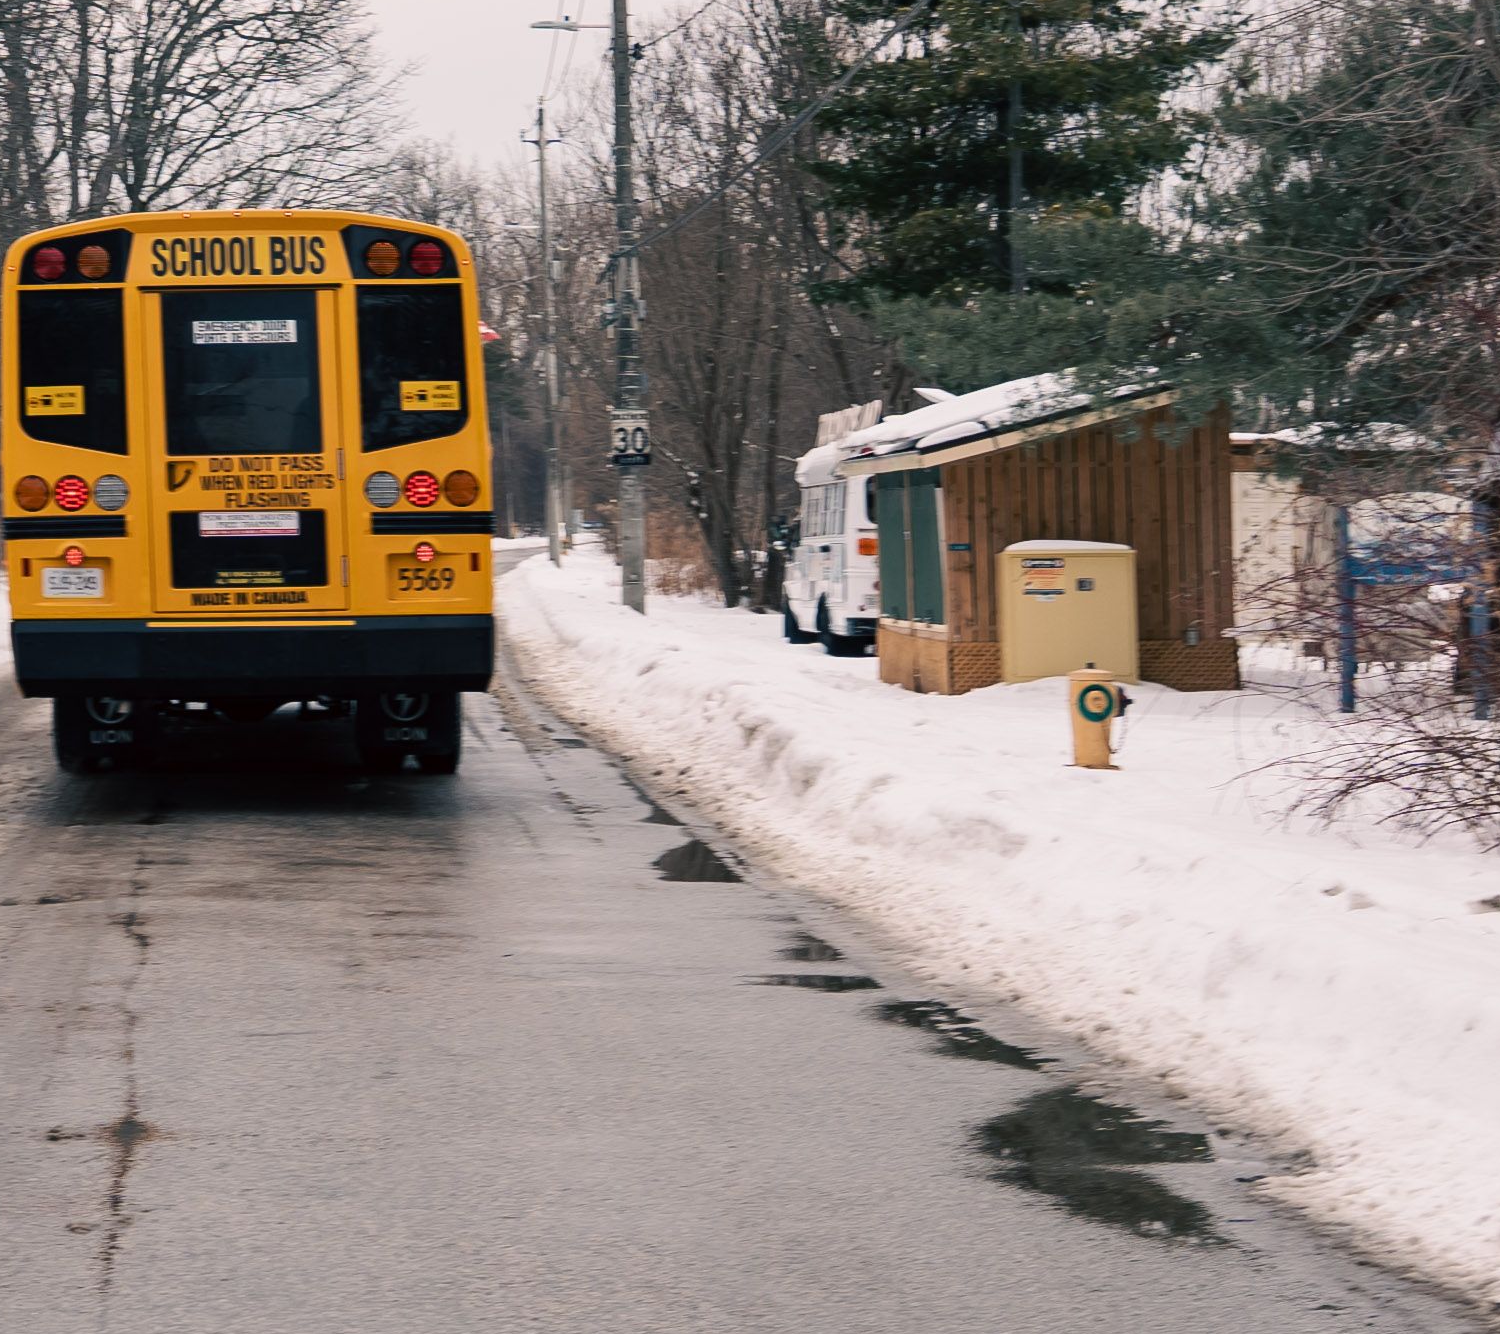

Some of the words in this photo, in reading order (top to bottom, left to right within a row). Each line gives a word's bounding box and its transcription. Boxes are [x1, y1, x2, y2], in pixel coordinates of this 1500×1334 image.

[151, 237, 262, 277] SCHOOL
[269, 235, 326, 275] BUS
[614, 426, 649, 454] 30
[208, 457, 234, 473] DO
[238, 457, 274, 472] NOT
[279, 456, 325, 472] PASS
[200, 475, 244, 491] WHEN
[247, 475, 279, 490] RED
[281, 474, 336, 490] LIGHTS
[225, 492, 312, 508] FLASHING
[397, 567, 456, 591] 5569
[190, 593, 231, 605] MADE
[234, 592, 249, 605] IN
[252, 591, 308, 605] CANADA
